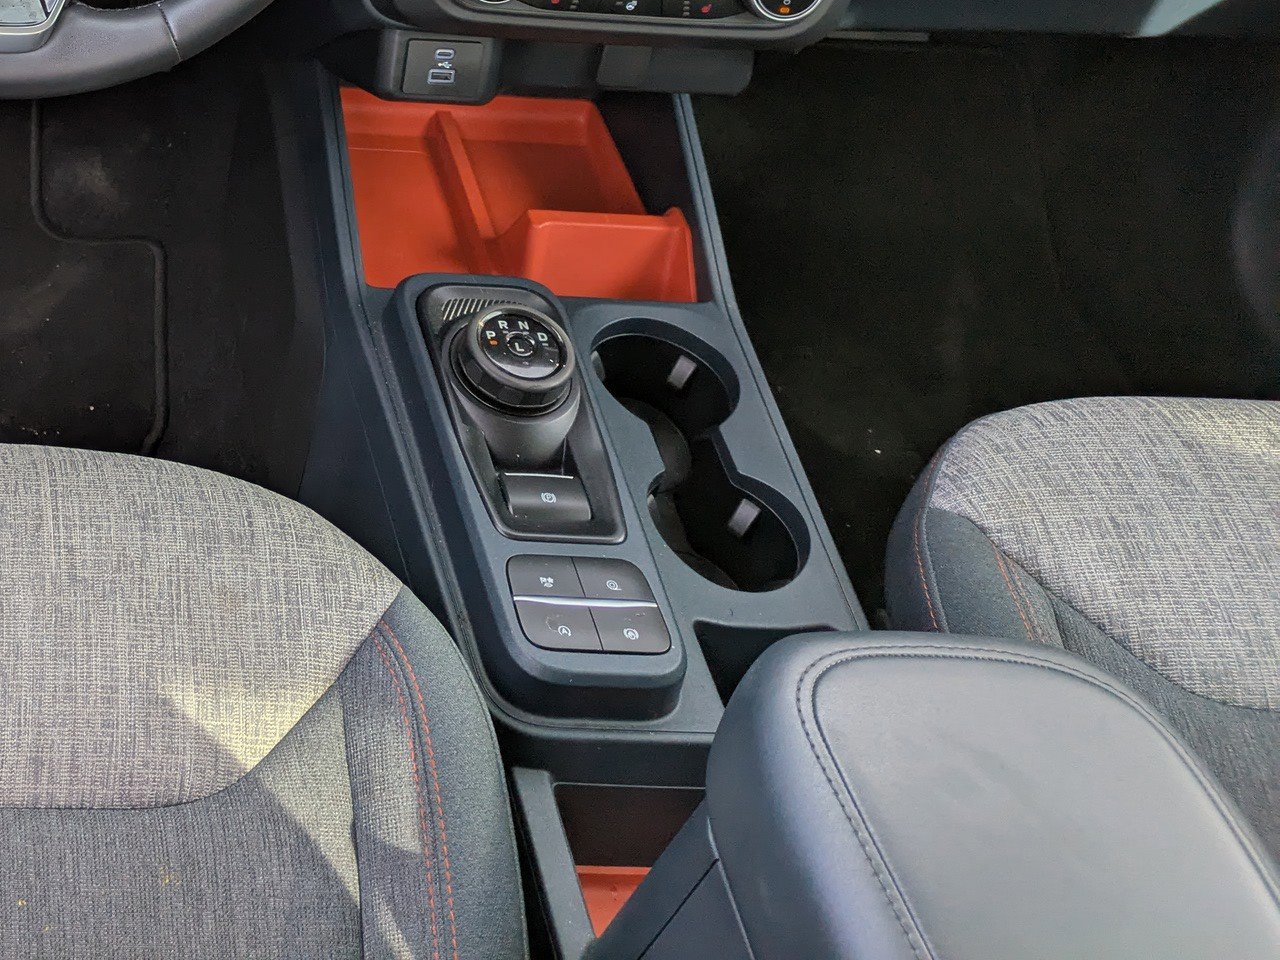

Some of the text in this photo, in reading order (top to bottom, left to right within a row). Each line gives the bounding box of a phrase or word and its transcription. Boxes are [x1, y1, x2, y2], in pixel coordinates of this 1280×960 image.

[498, 320, 509, 330] R
[518, 321, 530, 330] N
[486, 330, 496, 340] P
[537, 332, 548, 342] D
[515, 342, 525, 352] L
